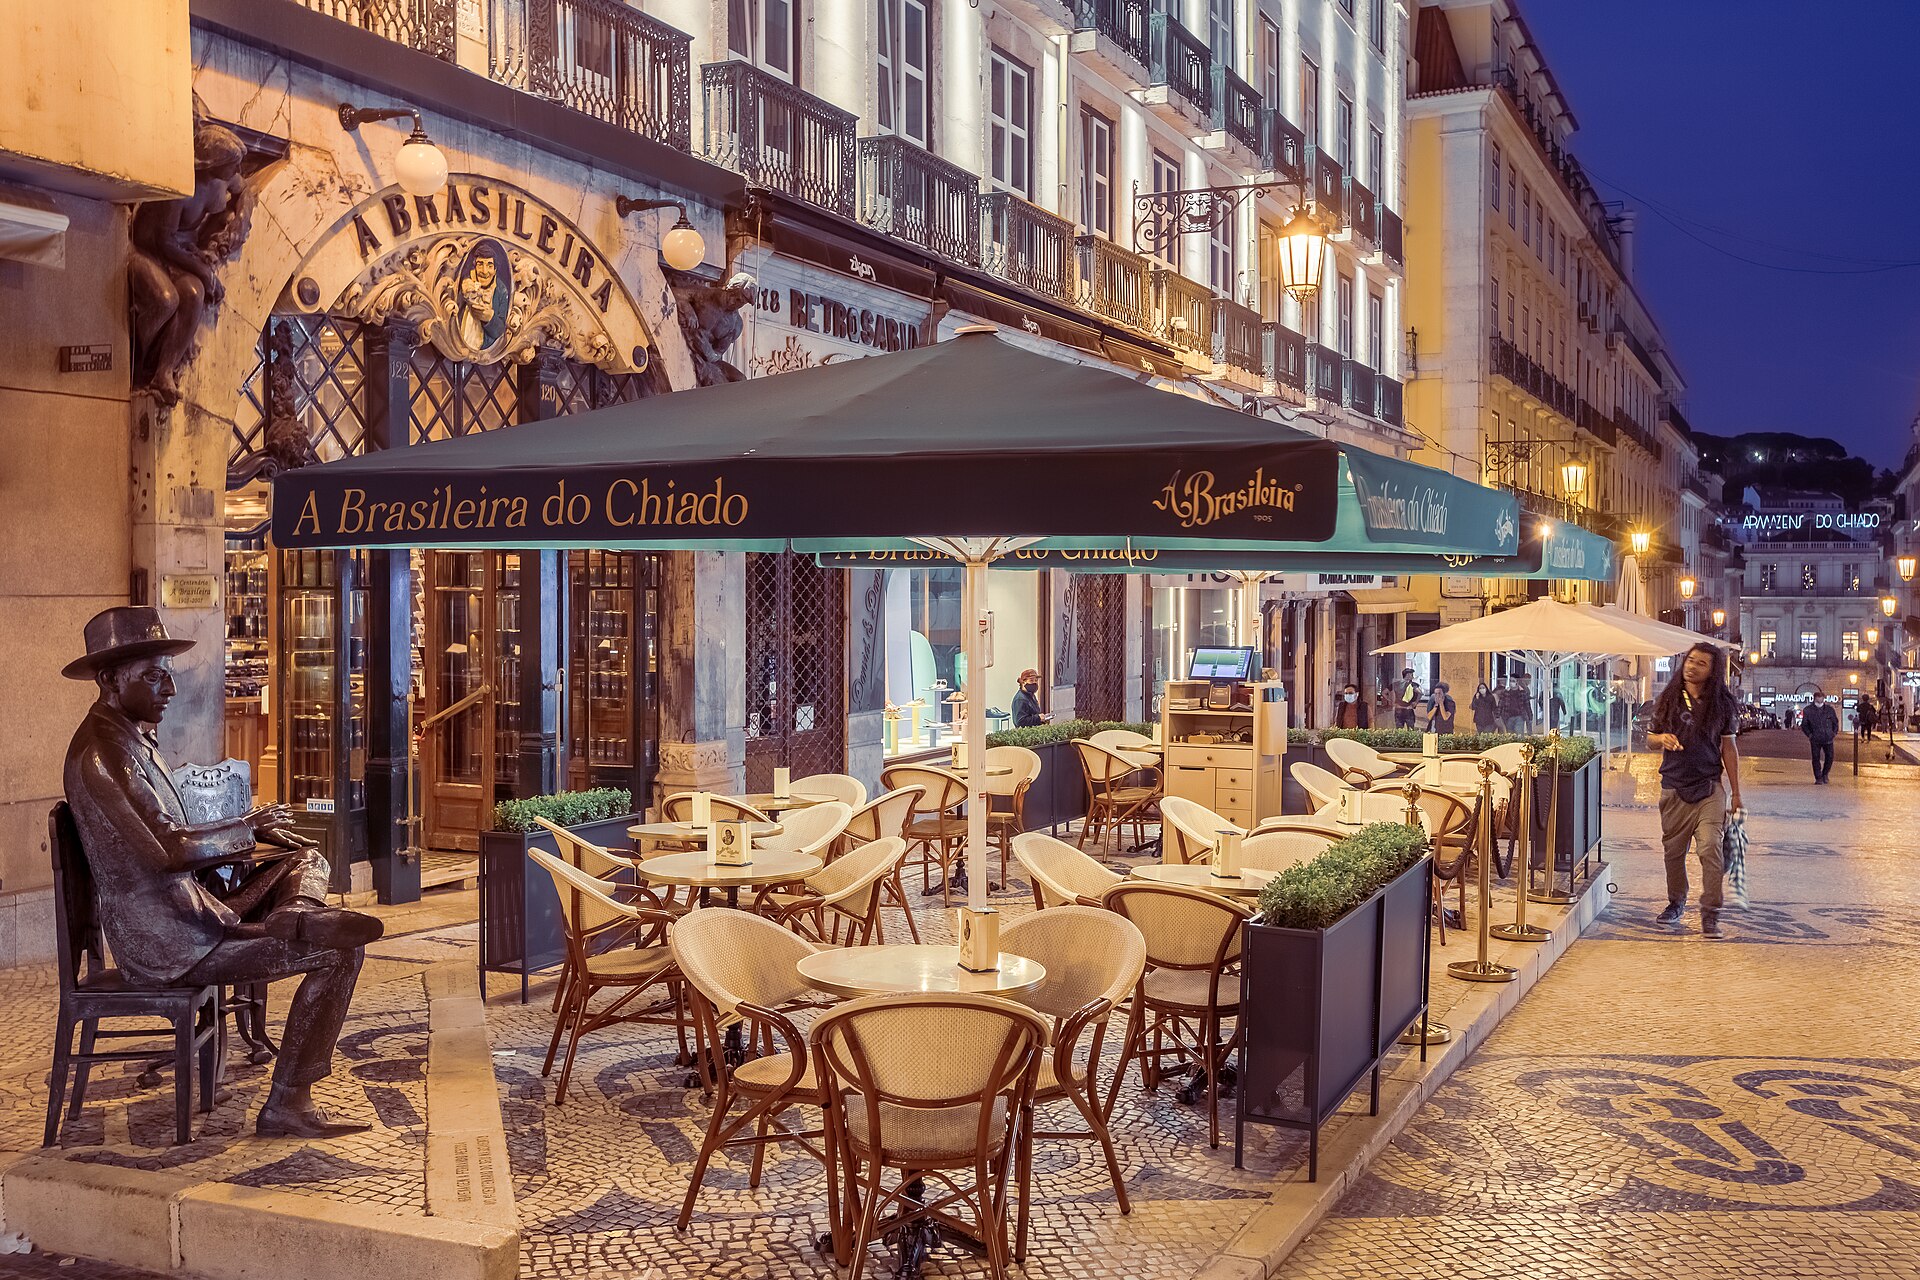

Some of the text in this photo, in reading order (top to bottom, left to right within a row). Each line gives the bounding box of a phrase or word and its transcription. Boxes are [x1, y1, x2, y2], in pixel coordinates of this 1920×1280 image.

[353, 185, 614, 313] A BRASILEIRA
[391, 361, 409, 380] 122
[541, 384, 555, 403] 120
[292, 476, 749, 536] A Brasileira do Chiado
[1152, 467, 1295, 528] A Brasileira
[1253, 514, 1273, 523] 1905
[1816, 513, 1832, 528] DO
[1836, 513, 1880, 528] CHIADO
